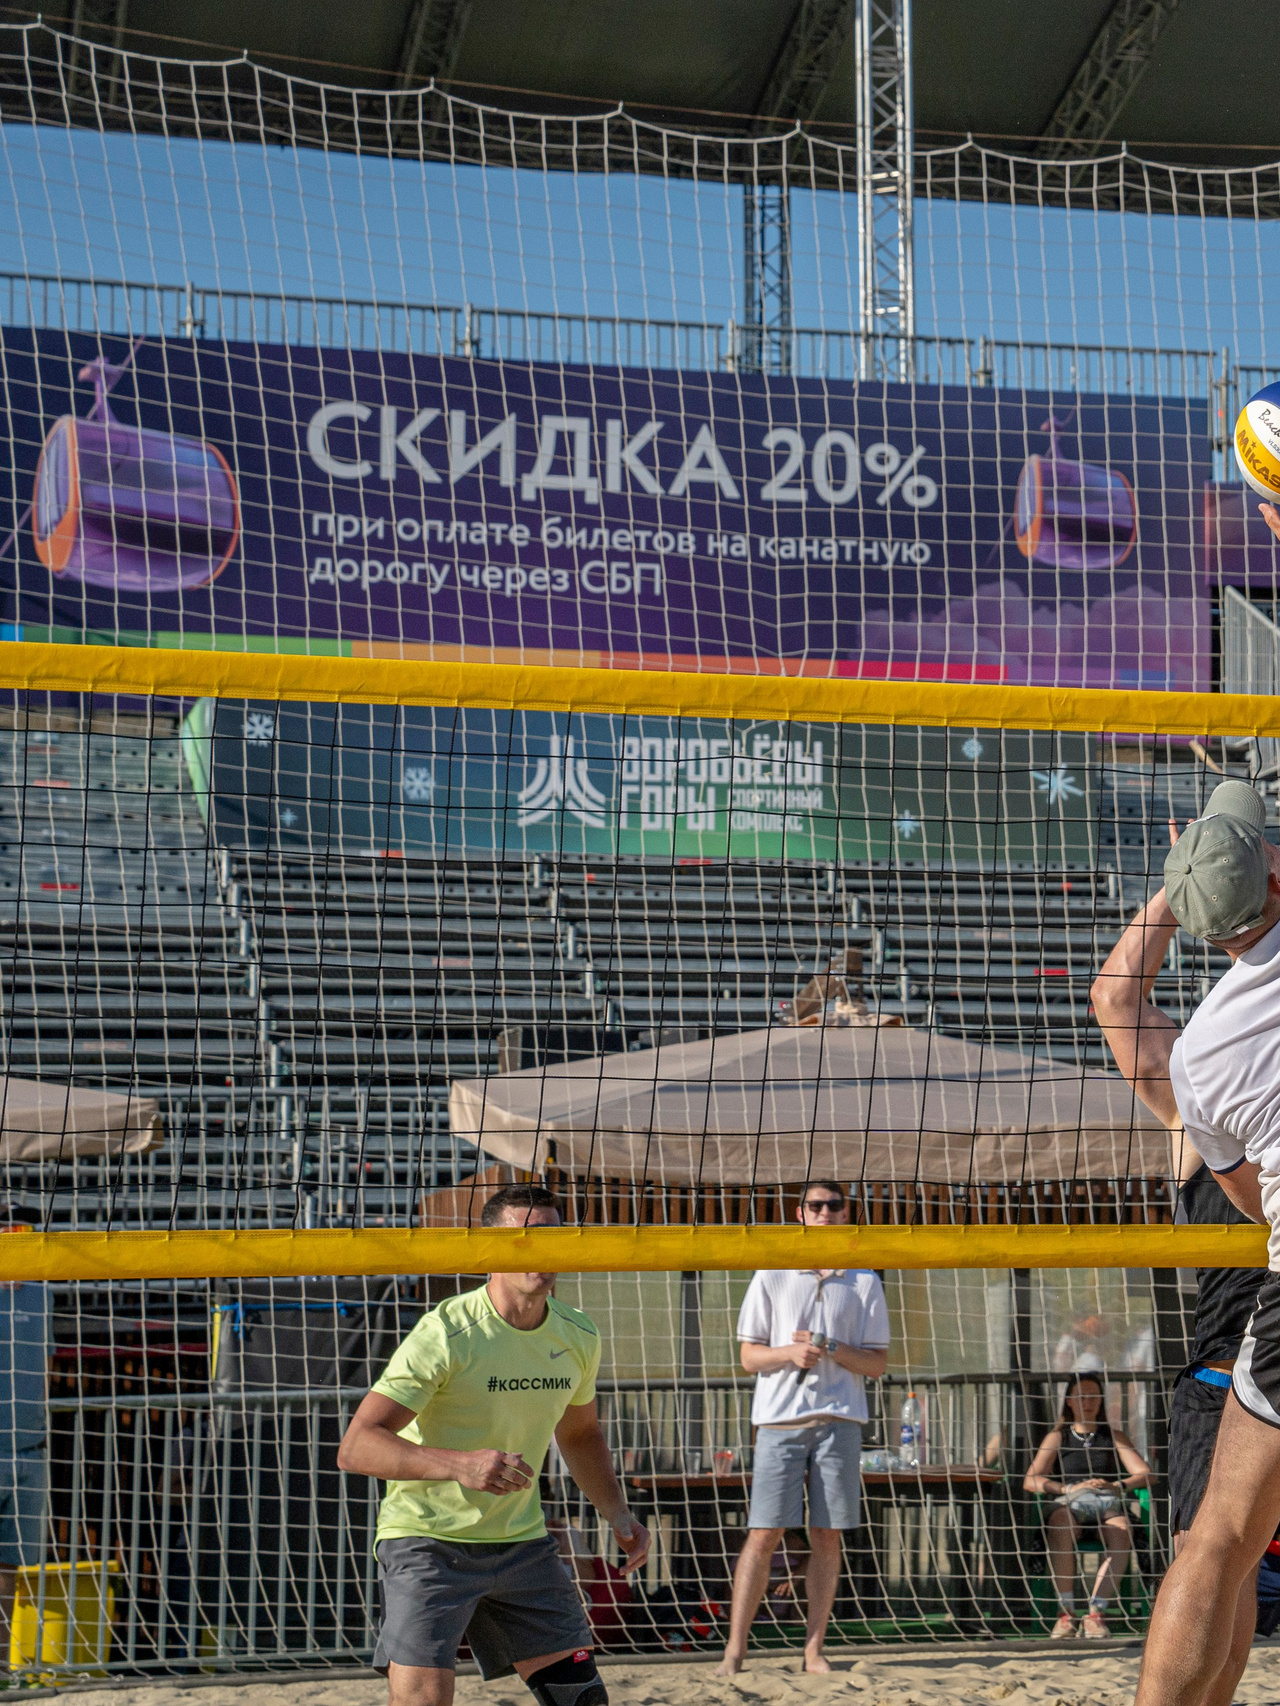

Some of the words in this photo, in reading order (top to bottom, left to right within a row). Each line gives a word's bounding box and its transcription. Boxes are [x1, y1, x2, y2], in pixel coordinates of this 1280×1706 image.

[306, 400, 742, 505] СКИДКА
[760, 426, 939, 508] 20%
[311, 512, 385, 546] при
[399, 516, 531, 548] оплате
[541, 517, 697, 556] билетов
[706, 530, 748, 557] на
[758, 535, 932, 571] канатную
[309, 557, 451, 594] дорогу
[460, 563, 571, 598] через
[580, 560, 662, 596] СБП
[620, 734, 823, 785] ВОРОБЬЁВЫ
[620, 784, 716, 830] ГОРЫ
[487, 1375, 572, 1393] #кассмик
